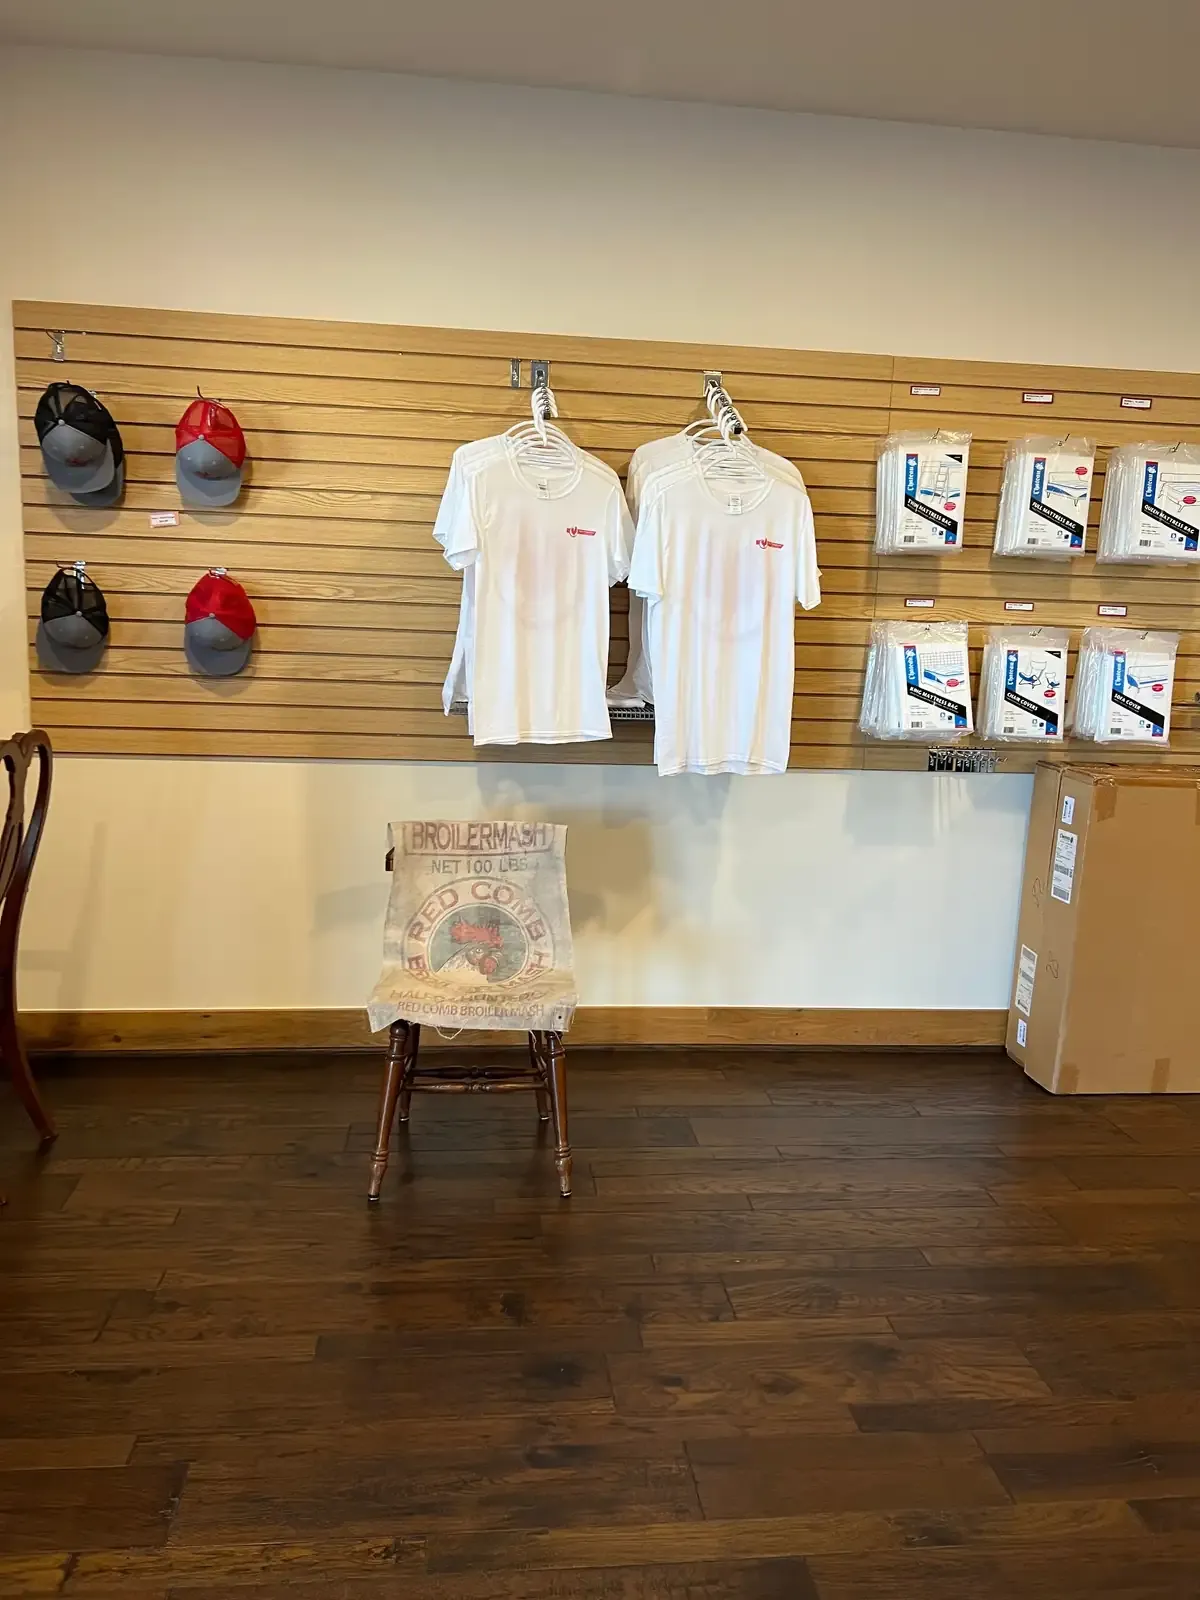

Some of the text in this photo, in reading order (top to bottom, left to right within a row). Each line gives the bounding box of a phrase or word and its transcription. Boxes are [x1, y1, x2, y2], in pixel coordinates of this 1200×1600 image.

[919, 504, 942, 520] MATTRESS
[941, 516, 952, 526] BAG
[1032, 501, 1076, 529] FULL MATTRESS BAG
[1144, 504, 1159, 516] QUEEN
[1160, 512, 1184, 529] MATTRESS
[1183, 524, 1195, 534] BAG
[909, 686, 959, 710] KING MATTRESS BAG
[1006, 692, 1038, 711] CHAIR COVERS
[1114, 693, 1141, 711] SOFA COVER
[432, 859, 461, 874] NET
[467, 859, 493, 875] 100
[408, 881, 546, 942] RED COMB
[398, 1001, 421, 1013] RED
[423, 1003, 458, 1016] COMB
